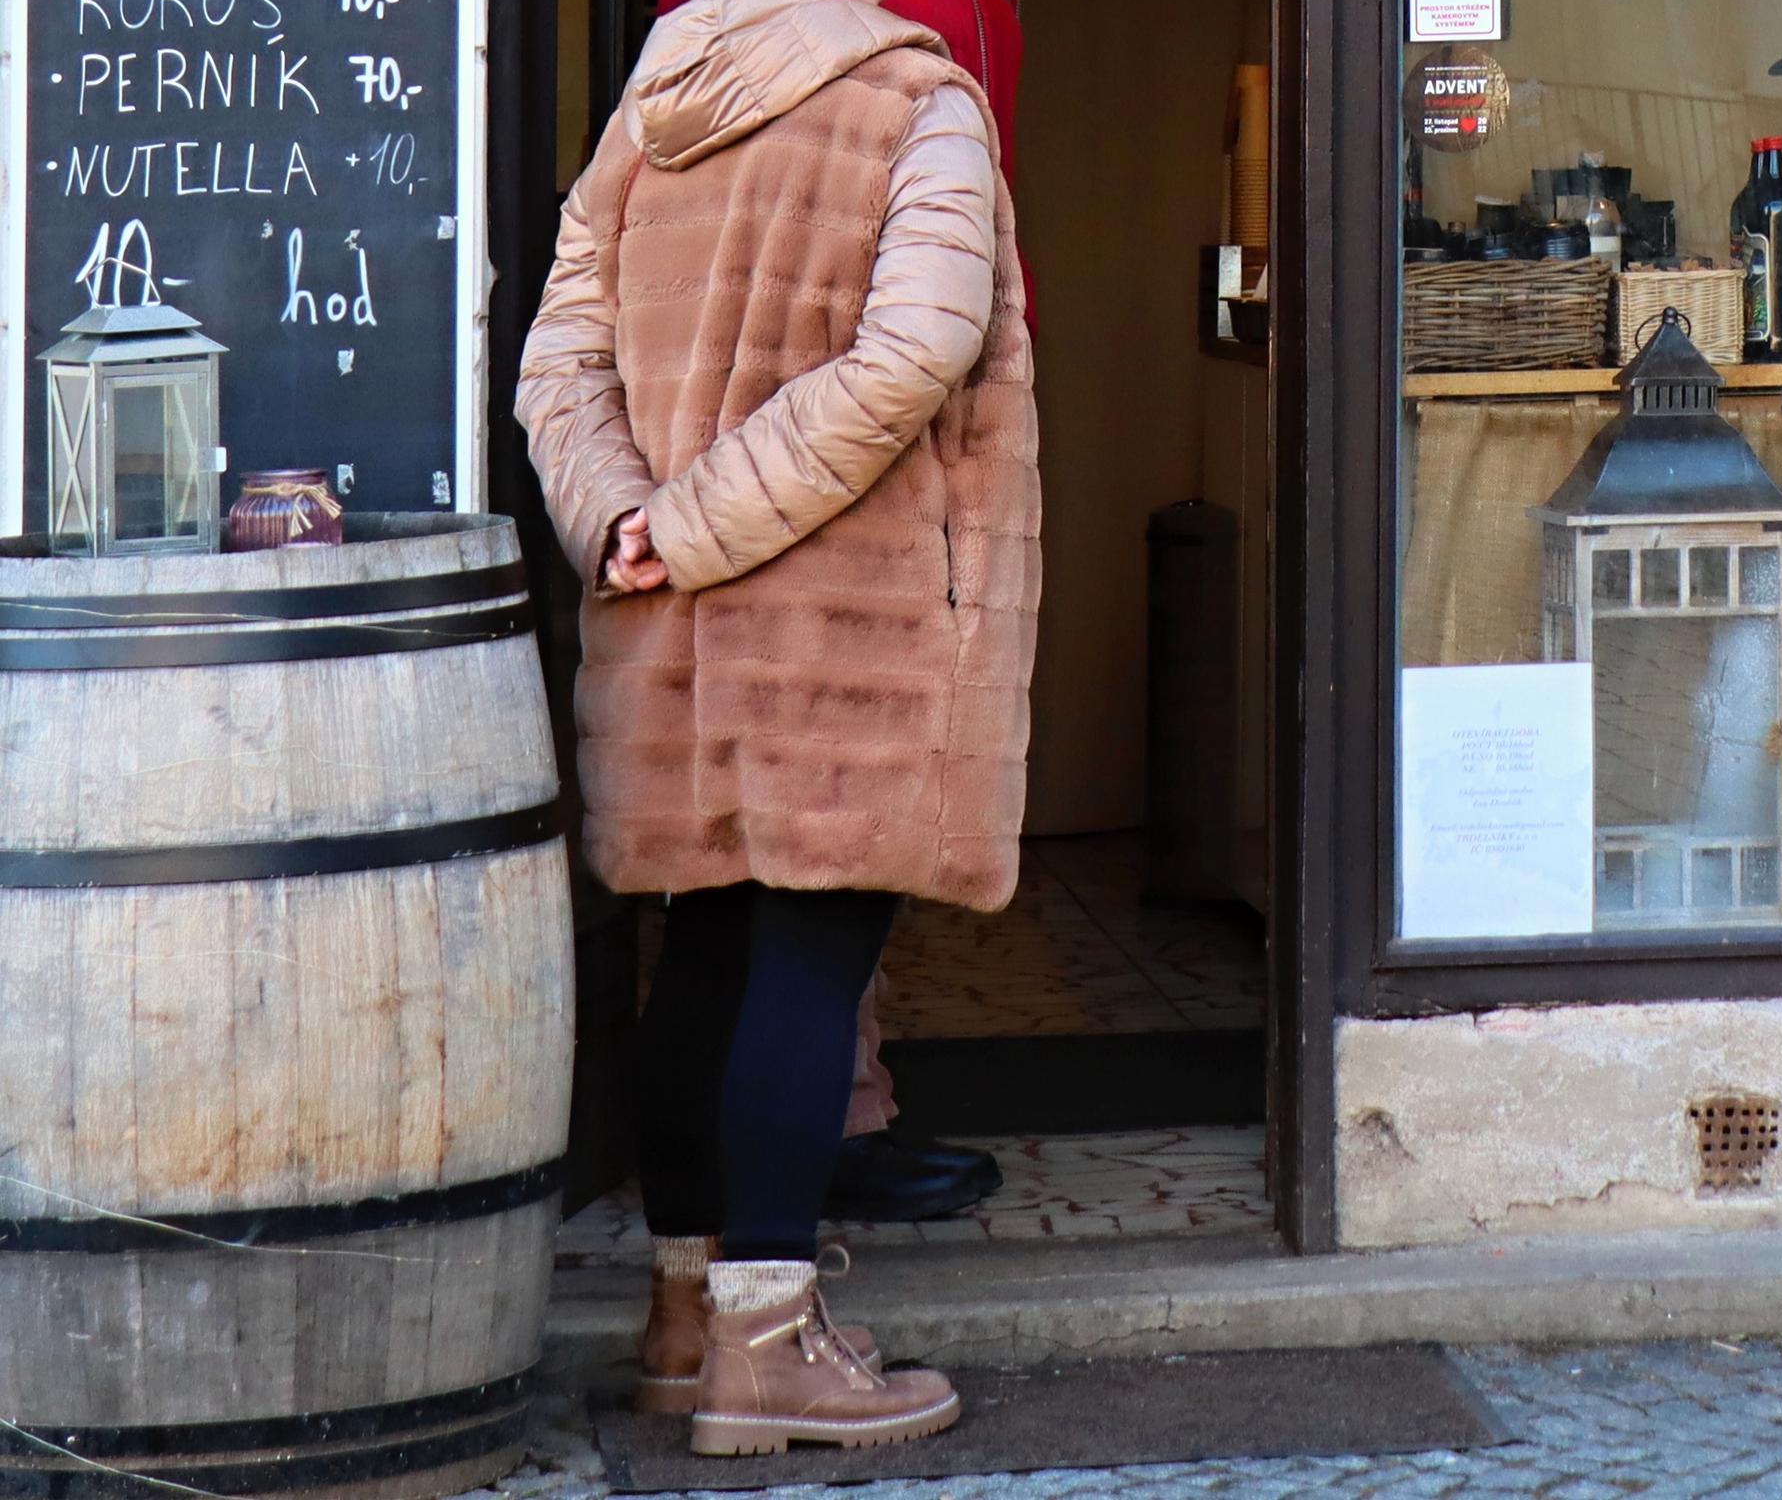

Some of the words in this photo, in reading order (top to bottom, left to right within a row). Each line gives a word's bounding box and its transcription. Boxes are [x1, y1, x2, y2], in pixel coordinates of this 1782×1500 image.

[79, 33, 320, 116] PERNÍK
[348, 55, 423, 111] 70,-
[1424, 79, 1487, 95] ADVENT
[64, 141, 318, 198] NUTELLA
[280, 227, 378, 327] hod
